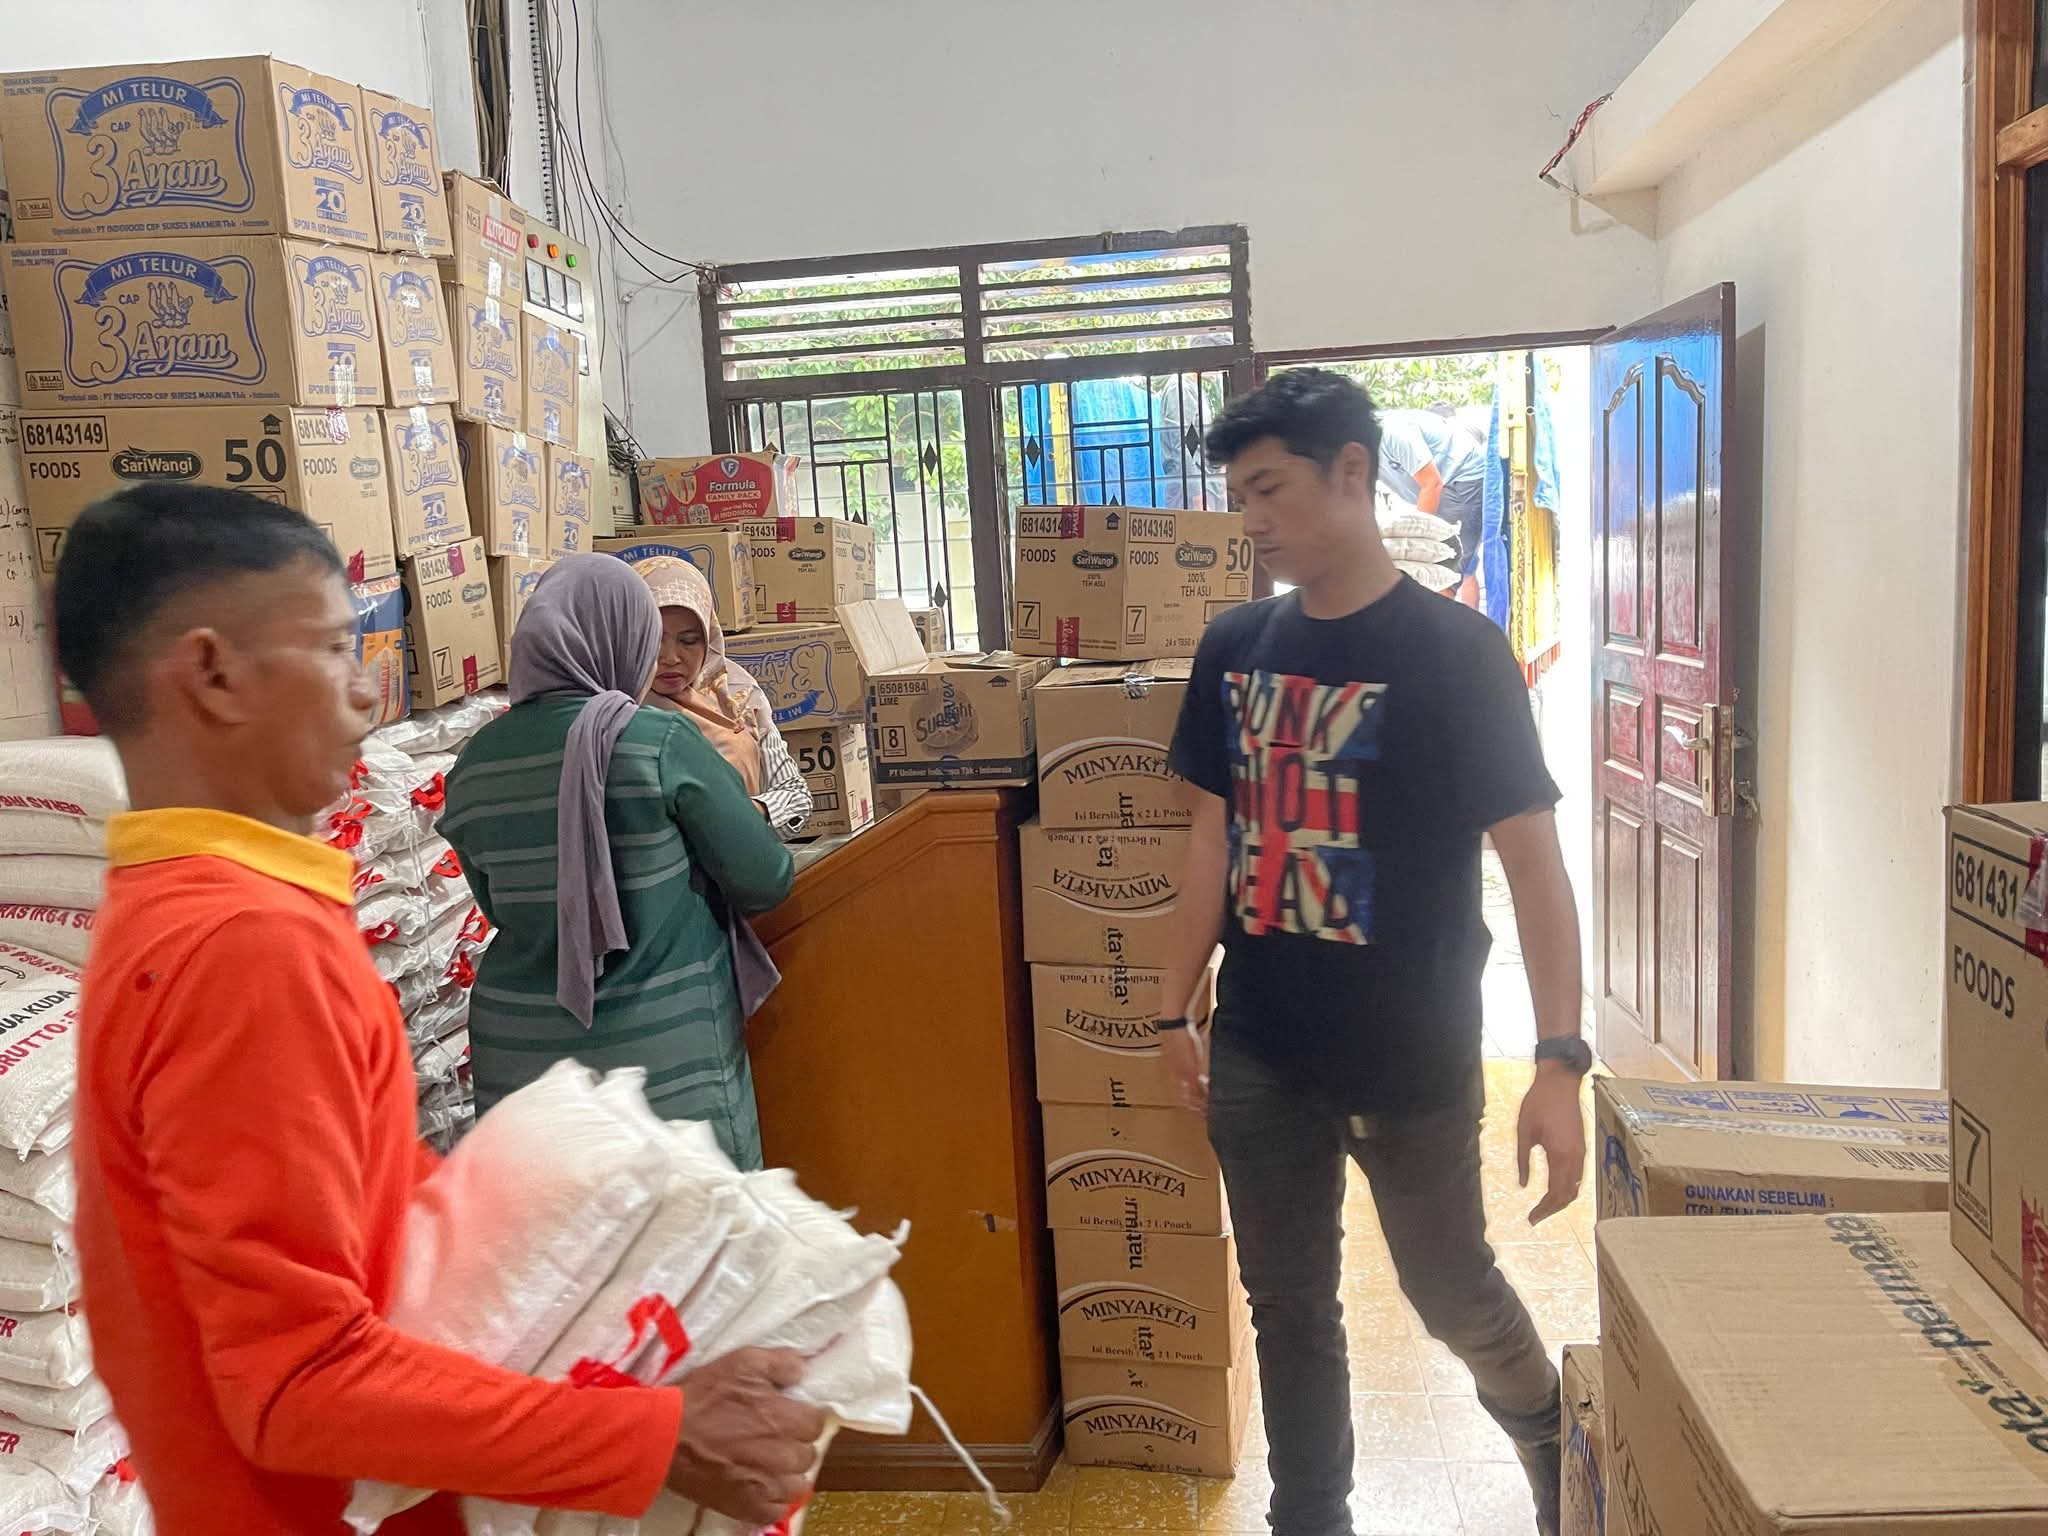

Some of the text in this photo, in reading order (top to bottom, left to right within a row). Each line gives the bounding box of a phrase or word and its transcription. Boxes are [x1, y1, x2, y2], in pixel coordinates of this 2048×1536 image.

[102, 84, 187, 108] MI TELUR
[110, 122, 131, 133] CAP
[82, 134, 220, 216] 3 Ayam
[316, 189, 346, 213] 20
[110, 257, 198, 280] MI TELUR
[119, 294, 140, 305] CAP
[91, 305, 232, 383] 3 Ayam
[26, 423, 103, 446] 68143149
[30, 461, 81, 479] FOODS
[120, 456, 193, 475] SariWangi
[225, 438, 287, 483] 50
[303, 457, 338, 476] FOODS
[707, 491, 760, 501] FAMILY PACK
[709, 480, 756, 493] Formula
[1130, 518, 1174, 538] 68143149
[749, 547, 776, 558] OODS
[1020, 548, 1056, 563] FOODS
[1075, 554, 1114, 568] SariWangi
[1129, 550, 1159, 565] FOODS
[1178, 546, 1214, 562] SariWangi
[1225, 537, 1252, 572] 50
[1187, 572, 1206, 583] 100%
[425, 589, 453, 610] FOODS
[1181, 585, 1212, 597] TEH ASLI
[1022, 605, 1035, 628] 7
[1130, 608, 1142, 633] 7
[436, 652, 447, 676] 7
[879, 682, 927, 695] 65081984
[880, 697, 899, 705] LIME
[888, 729, 899, 748] 8
[799, 745, 836, 774] 50
[1163, 808, 1193, 818] Pouch
[1052, 867, 1172, 900] MINYAKITA
[1955, 850, 2020, 918] 681431
[0, 903, 30, 920] RAS
[29, 904, 70, 926] IR64
[1952, 943, 2017, 1019] FOODS
[22, 990, 79, 1016] KUDA
[1065, 1008, 1160, 1039] NYAKITA
[1961, 1116, 1982, 1186] 7
[1068, 1167, 1187, 1198] MINYAKITA
[1685, 1184, 1827, 1208] GUNAKAN SEBELUM
[1080, 1299, 1197, 1331] MINYAKITA
[1084, 1413, 1198, 1446] MINYAKITA
